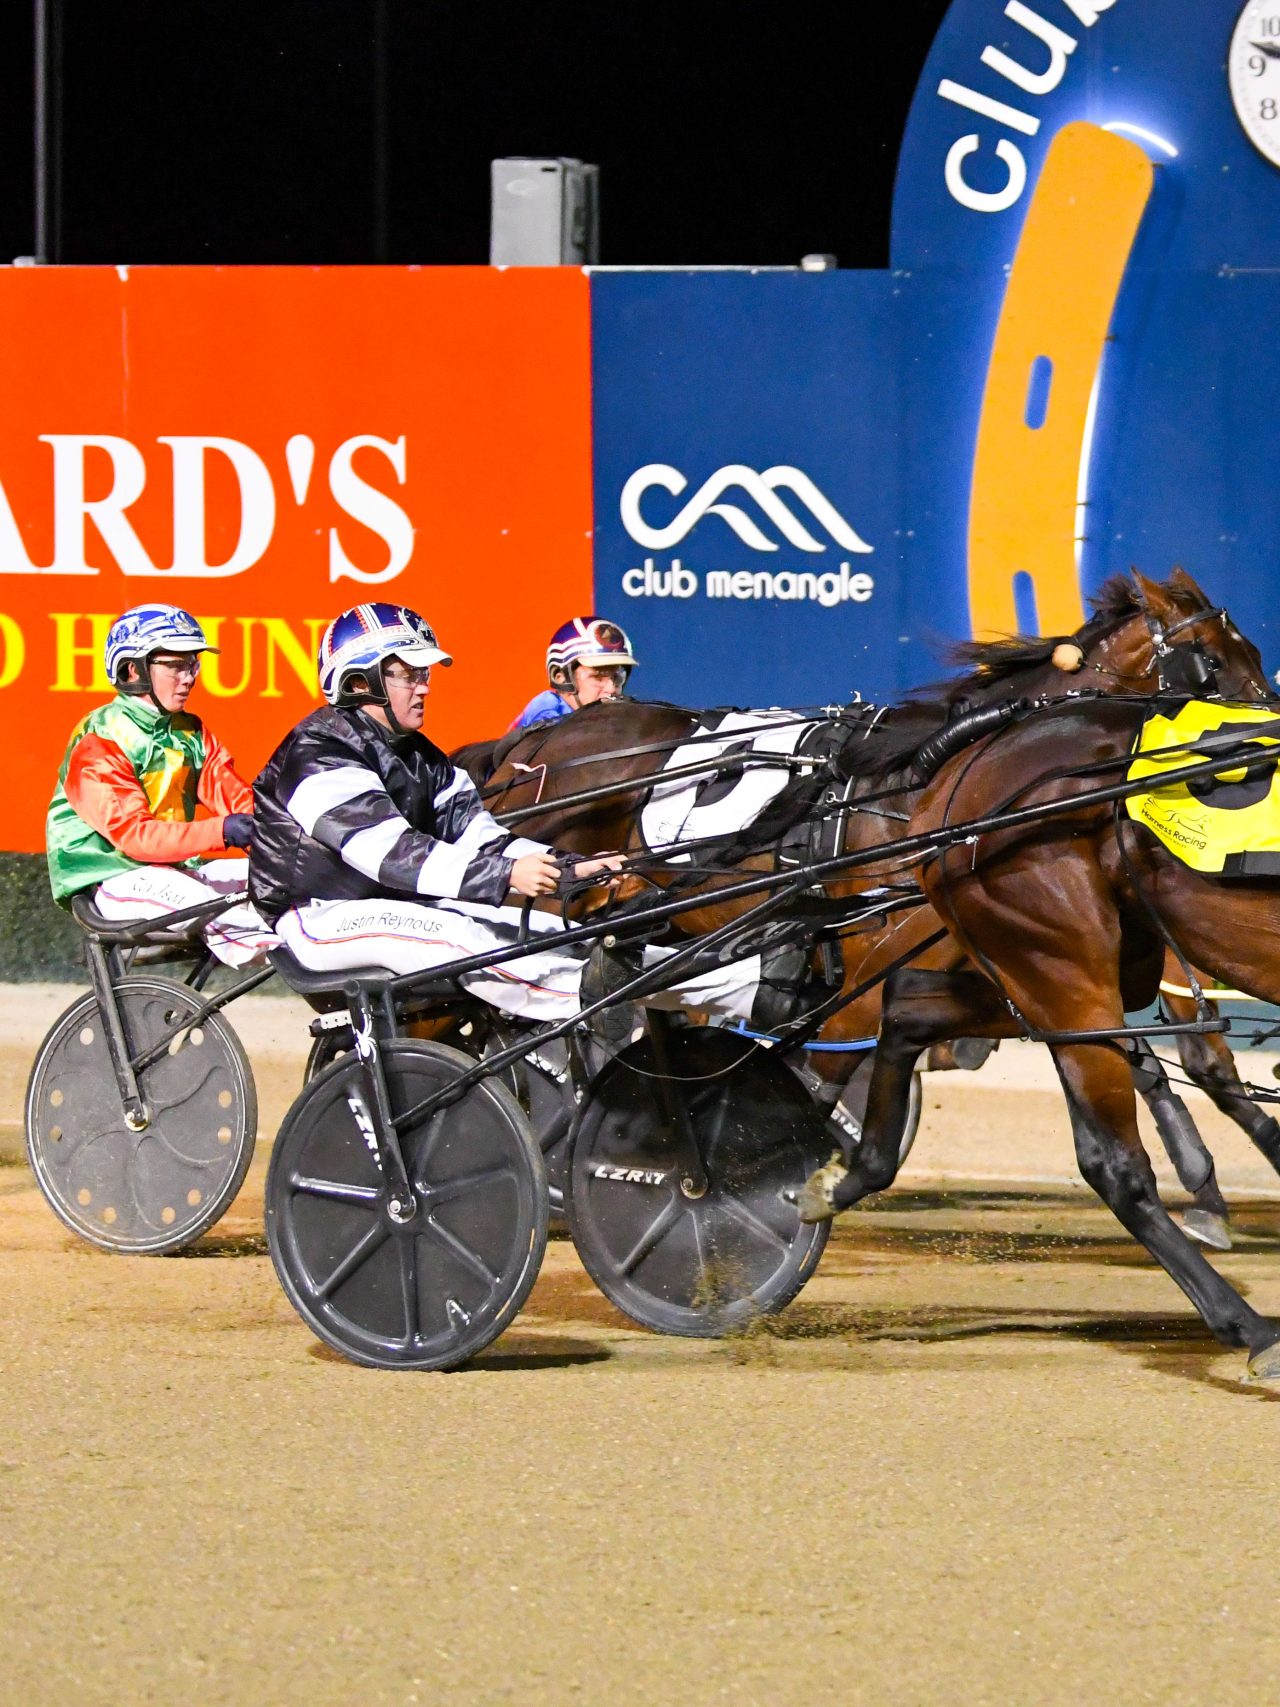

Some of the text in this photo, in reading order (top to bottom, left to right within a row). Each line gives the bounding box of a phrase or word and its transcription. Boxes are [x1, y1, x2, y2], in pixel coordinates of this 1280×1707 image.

[1249, 55, 1267, 77] 9
[1260, 98, 1278, 120] 8
[0, 434, 415, 584] RD'S
[622, 558, 874, 607] club menangle
[1141, 808, 1172, 835] Harness
[1173, 830, 1207, 850] Racing
[337, 915, 375, 933] Justin
[348, 1098, 383, 1171] LZR
